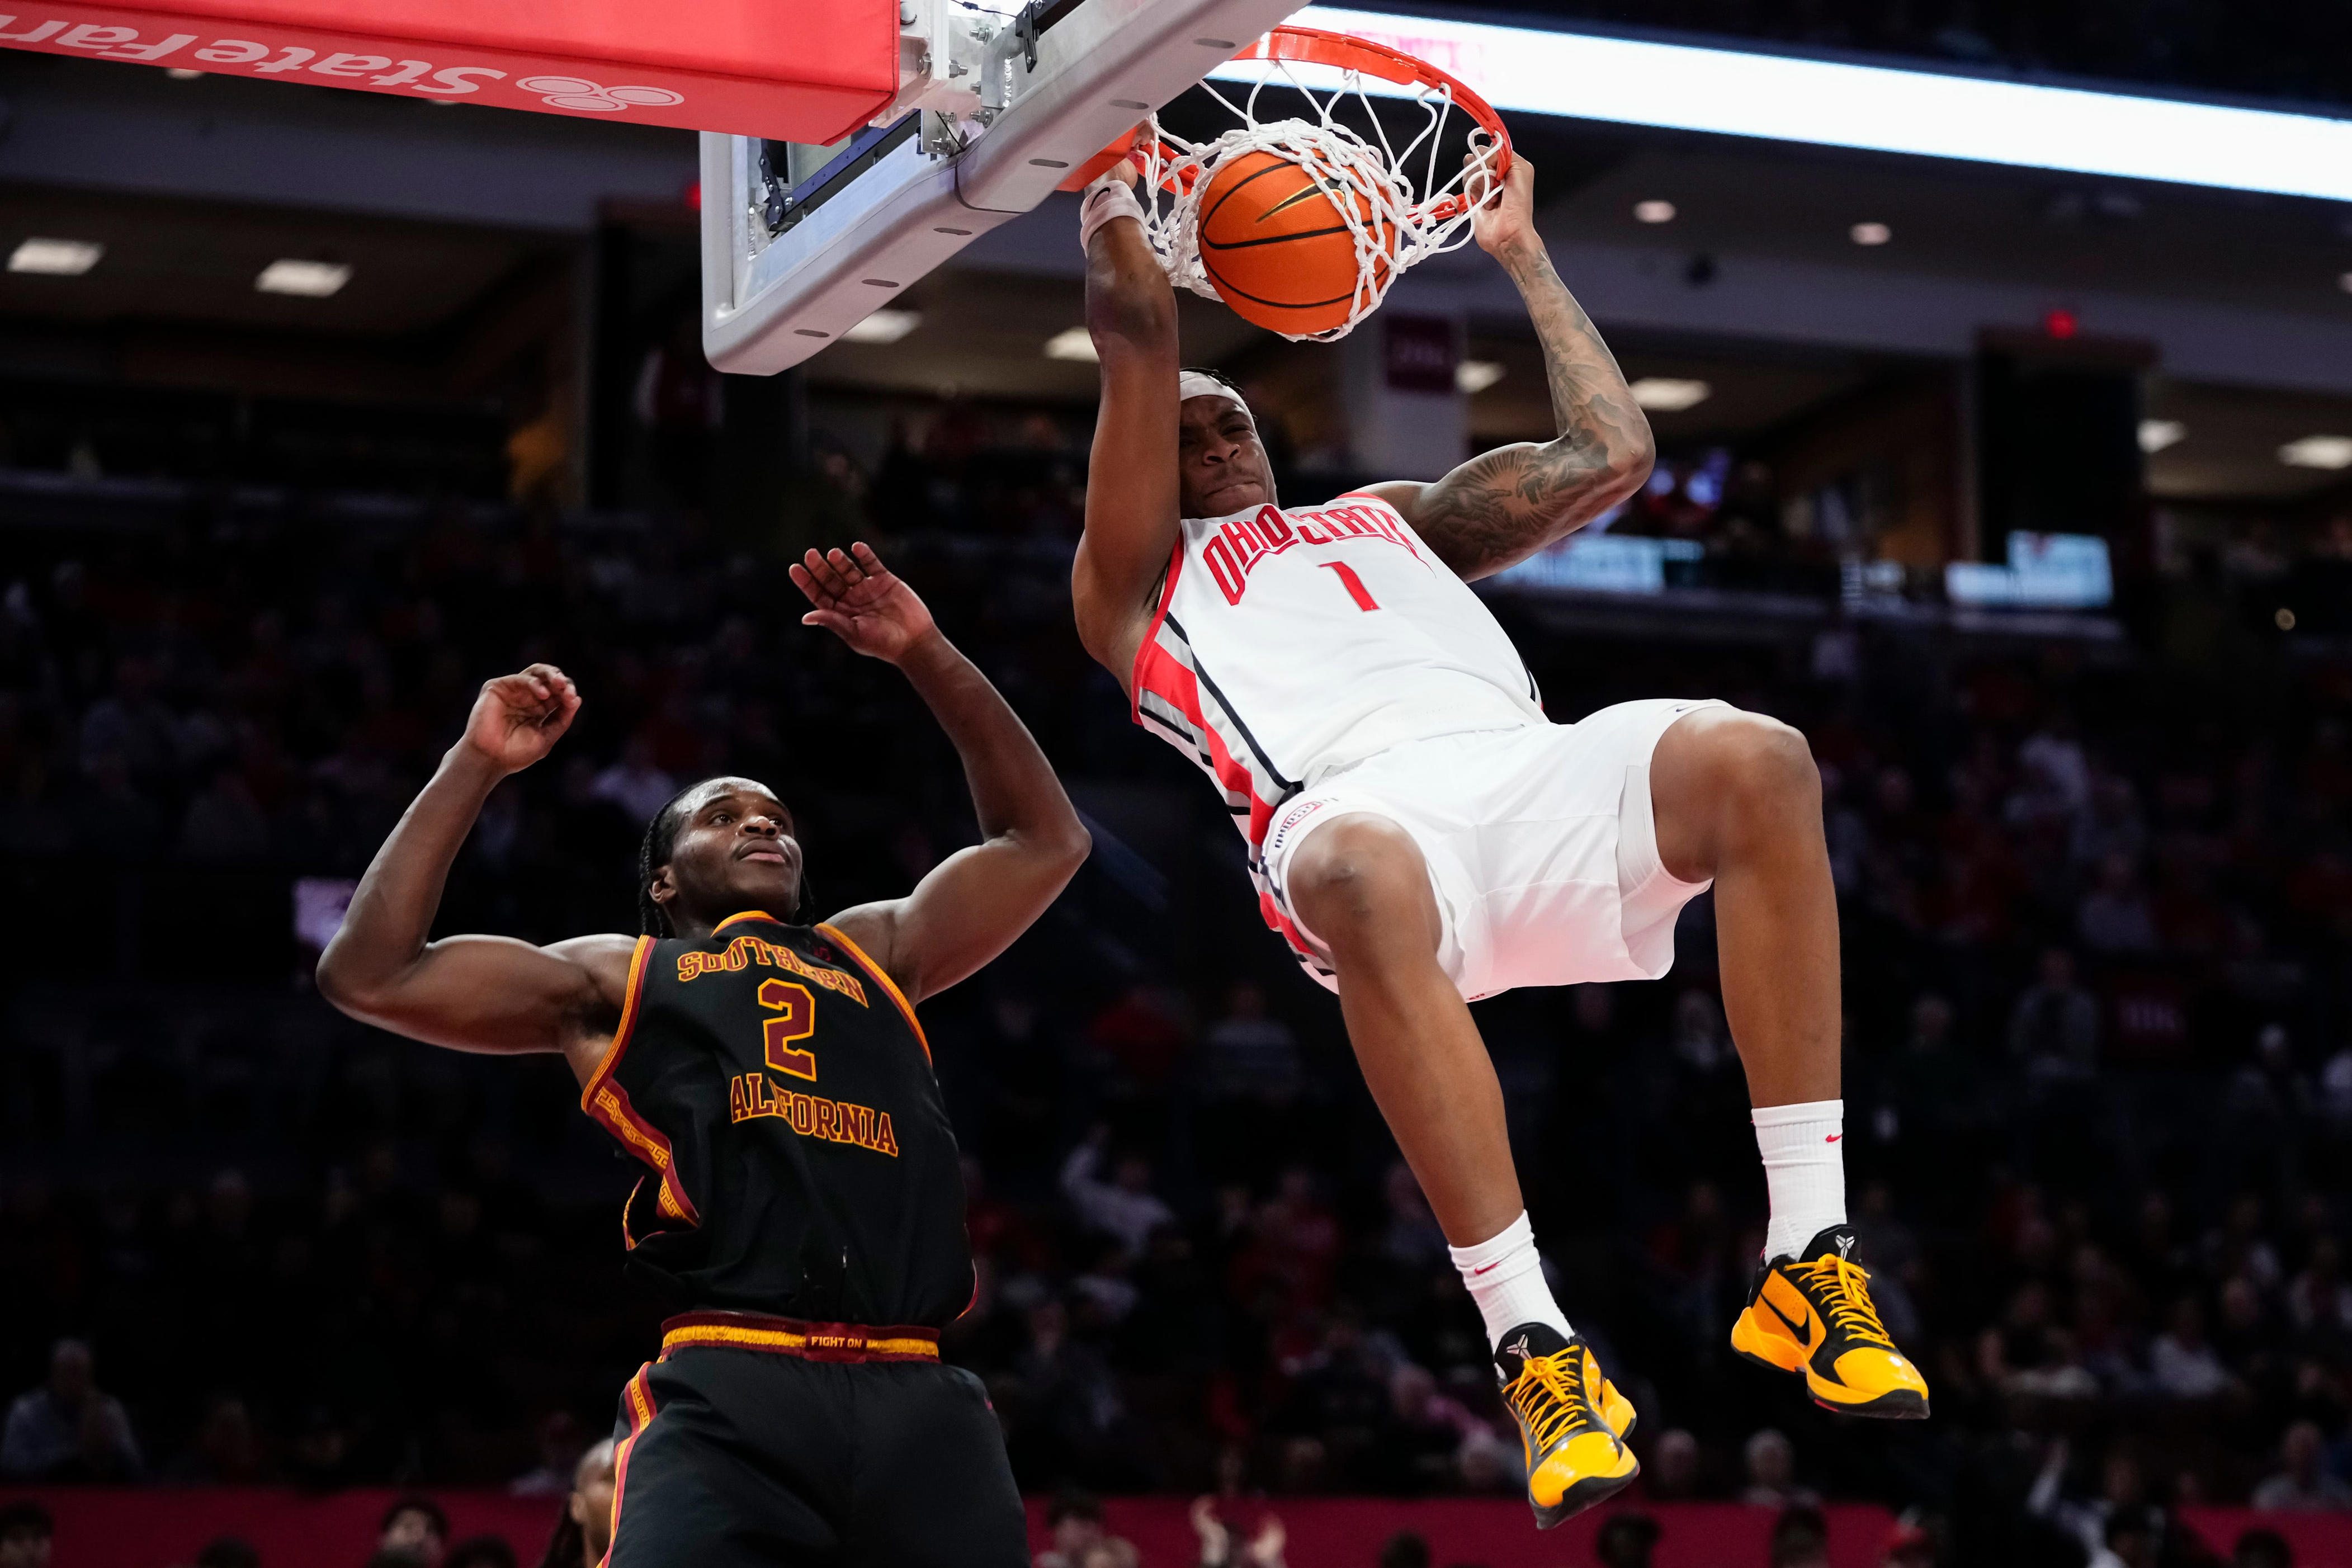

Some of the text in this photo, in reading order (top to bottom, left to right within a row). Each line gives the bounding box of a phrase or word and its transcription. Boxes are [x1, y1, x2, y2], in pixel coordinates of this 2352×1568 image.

[0, 15, 199, 61] Far
[1203, 504, 1418, 606] OHIO STATE
[1316, 560, 1382, 612] 1
[758, 978, 816, 1081] 2
[731, 1073, 898, 1157] ALFORNIA
[811, 1336, 862, 1348] FIGHT ON
